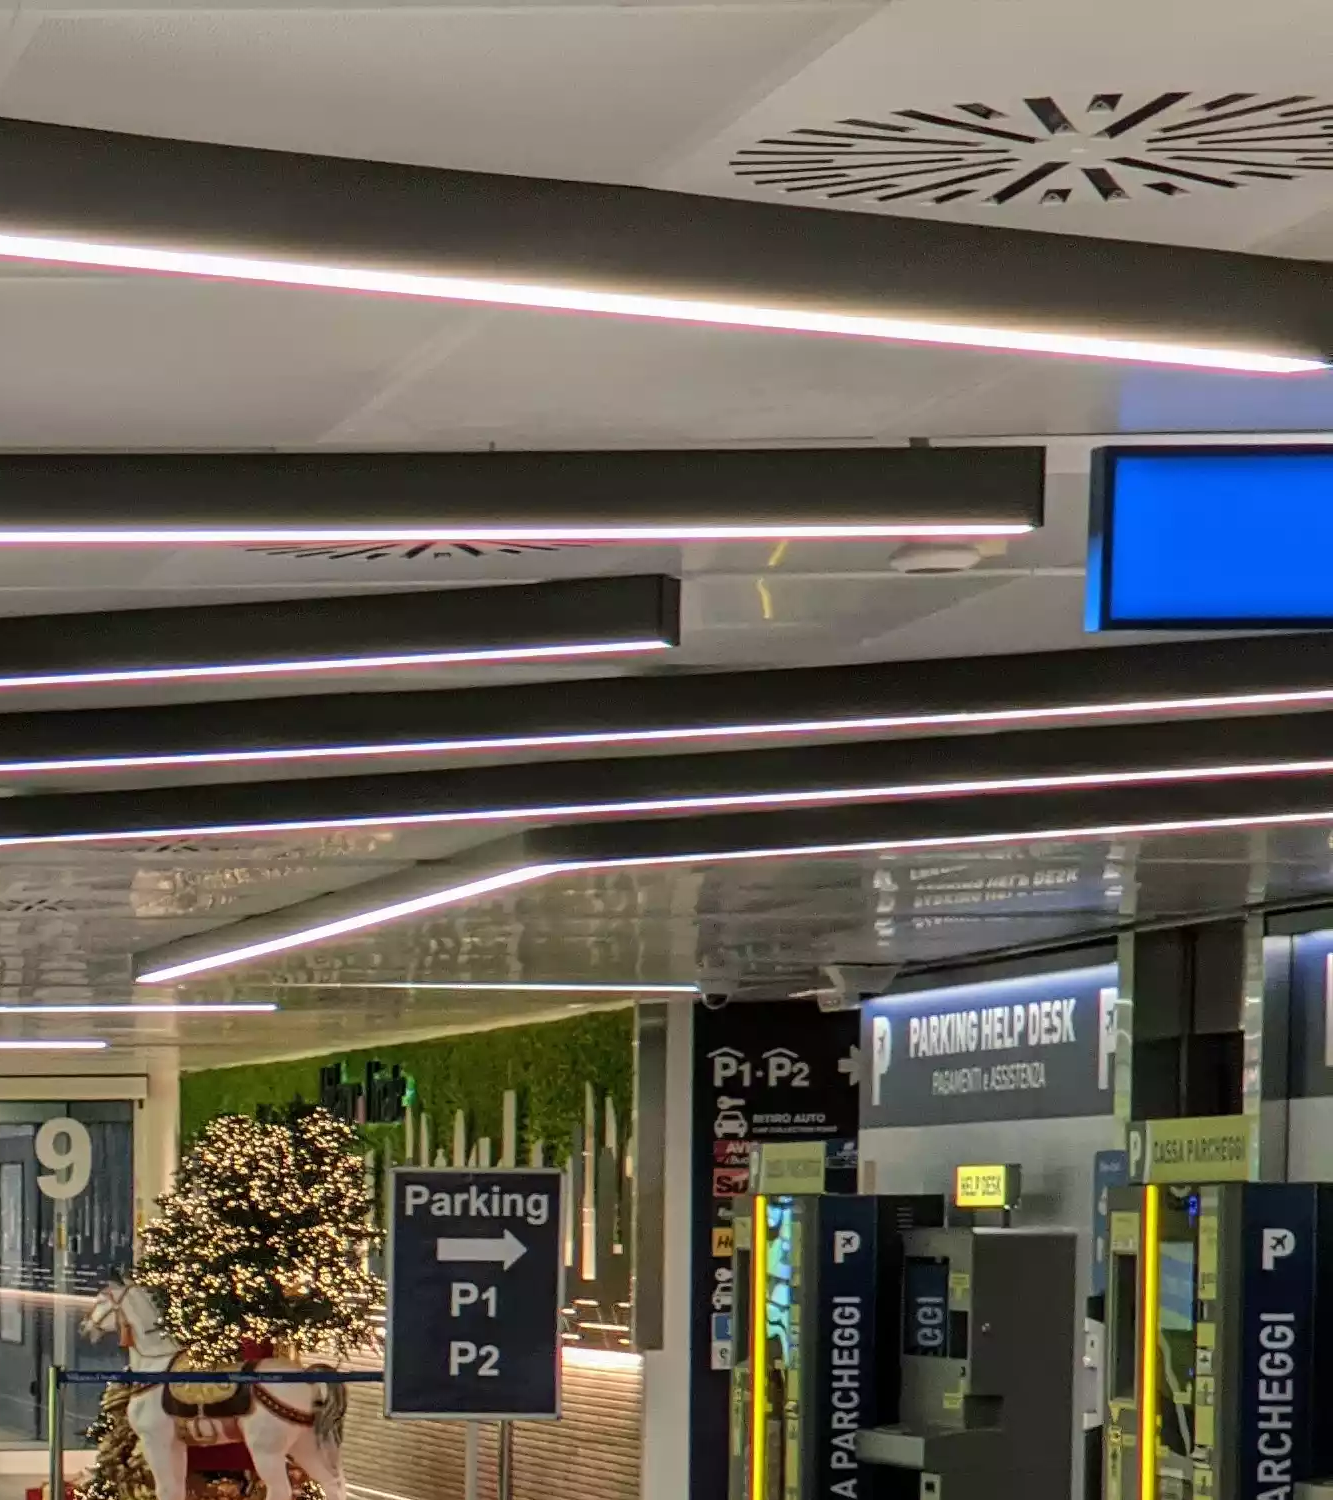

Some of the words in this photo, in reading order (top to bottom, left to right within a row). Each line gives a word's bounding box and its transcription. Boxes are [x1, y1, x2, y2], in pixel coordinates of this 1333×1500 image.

[909, 1010, 979, 1058] PARKING
[981, 1004, 1025, 1051] HELP
[1028, 998, 1077, 1046] DESK
[794, 1113, 826, 1124] AUTO
[34, 1116, 92, 1200] 9
[403, 1184, 551, 1225] Parking
[450, 1282, 498, 1318] P1
[449, 1341, 501, 1377] P2
[831, 1296, 862, 1469] PARCHEGGI
